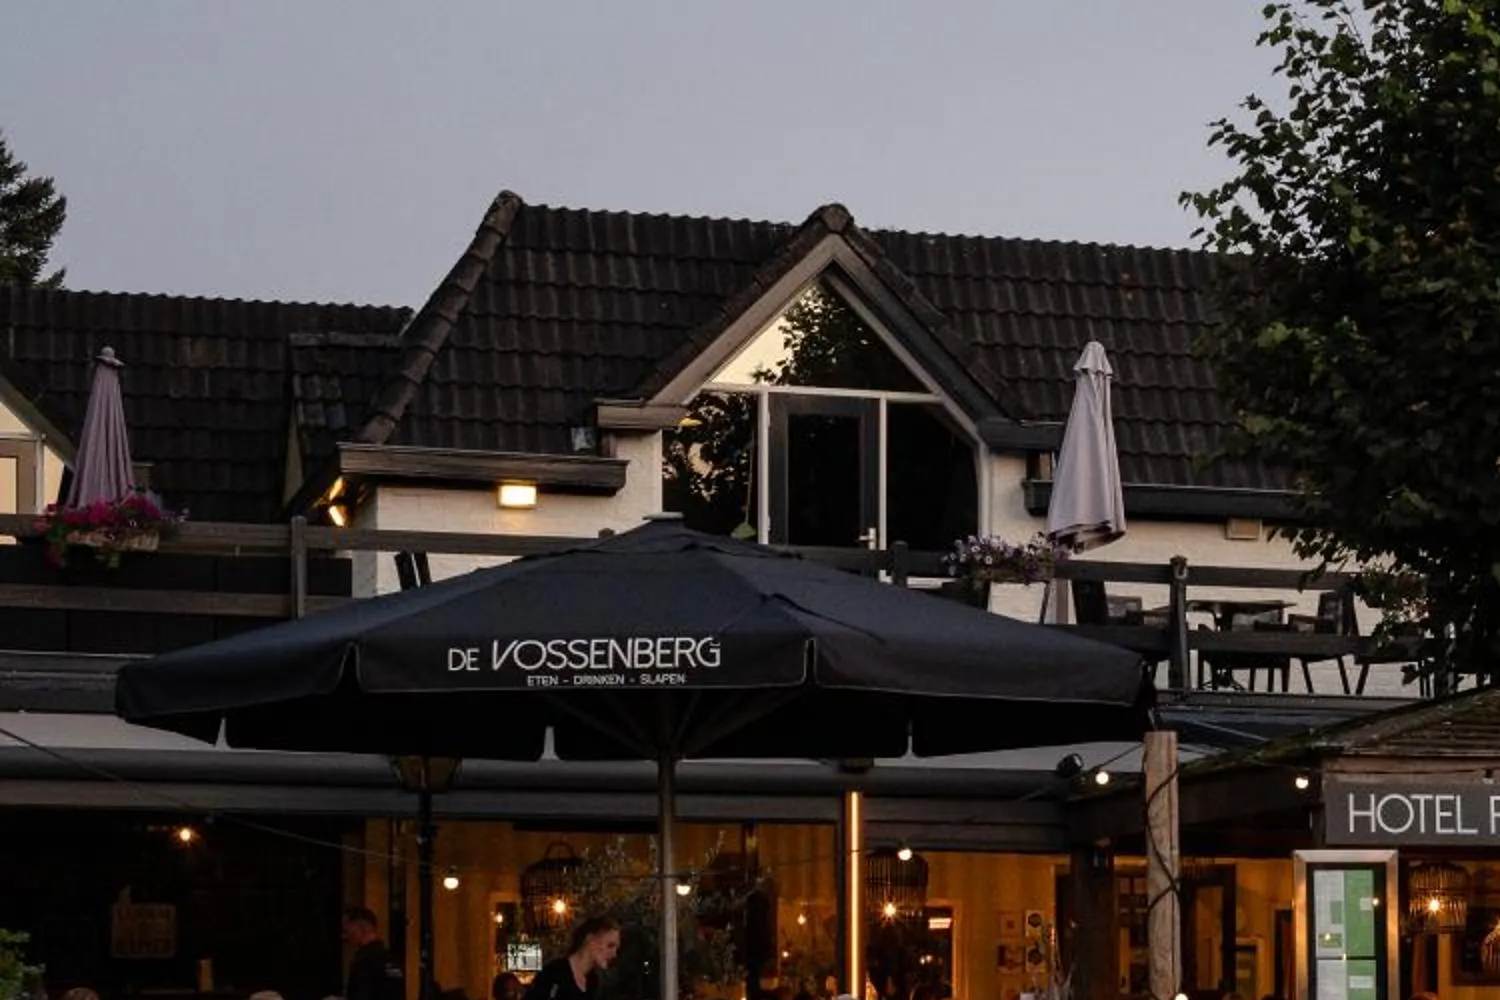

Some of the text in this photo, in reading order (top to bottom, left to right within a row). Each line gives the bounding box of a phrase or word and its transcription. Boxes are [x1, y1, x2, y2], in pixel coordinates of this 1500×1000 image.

[447, 637, 721, 671] DE VOSSENBERG
[527, 675, 559, 686] ETEN
[573, 674, 625, 685] DRINKEN
[639, 673, 686, 685] SLAPEN
[1349, 794, 1478, 833] HOTEL
